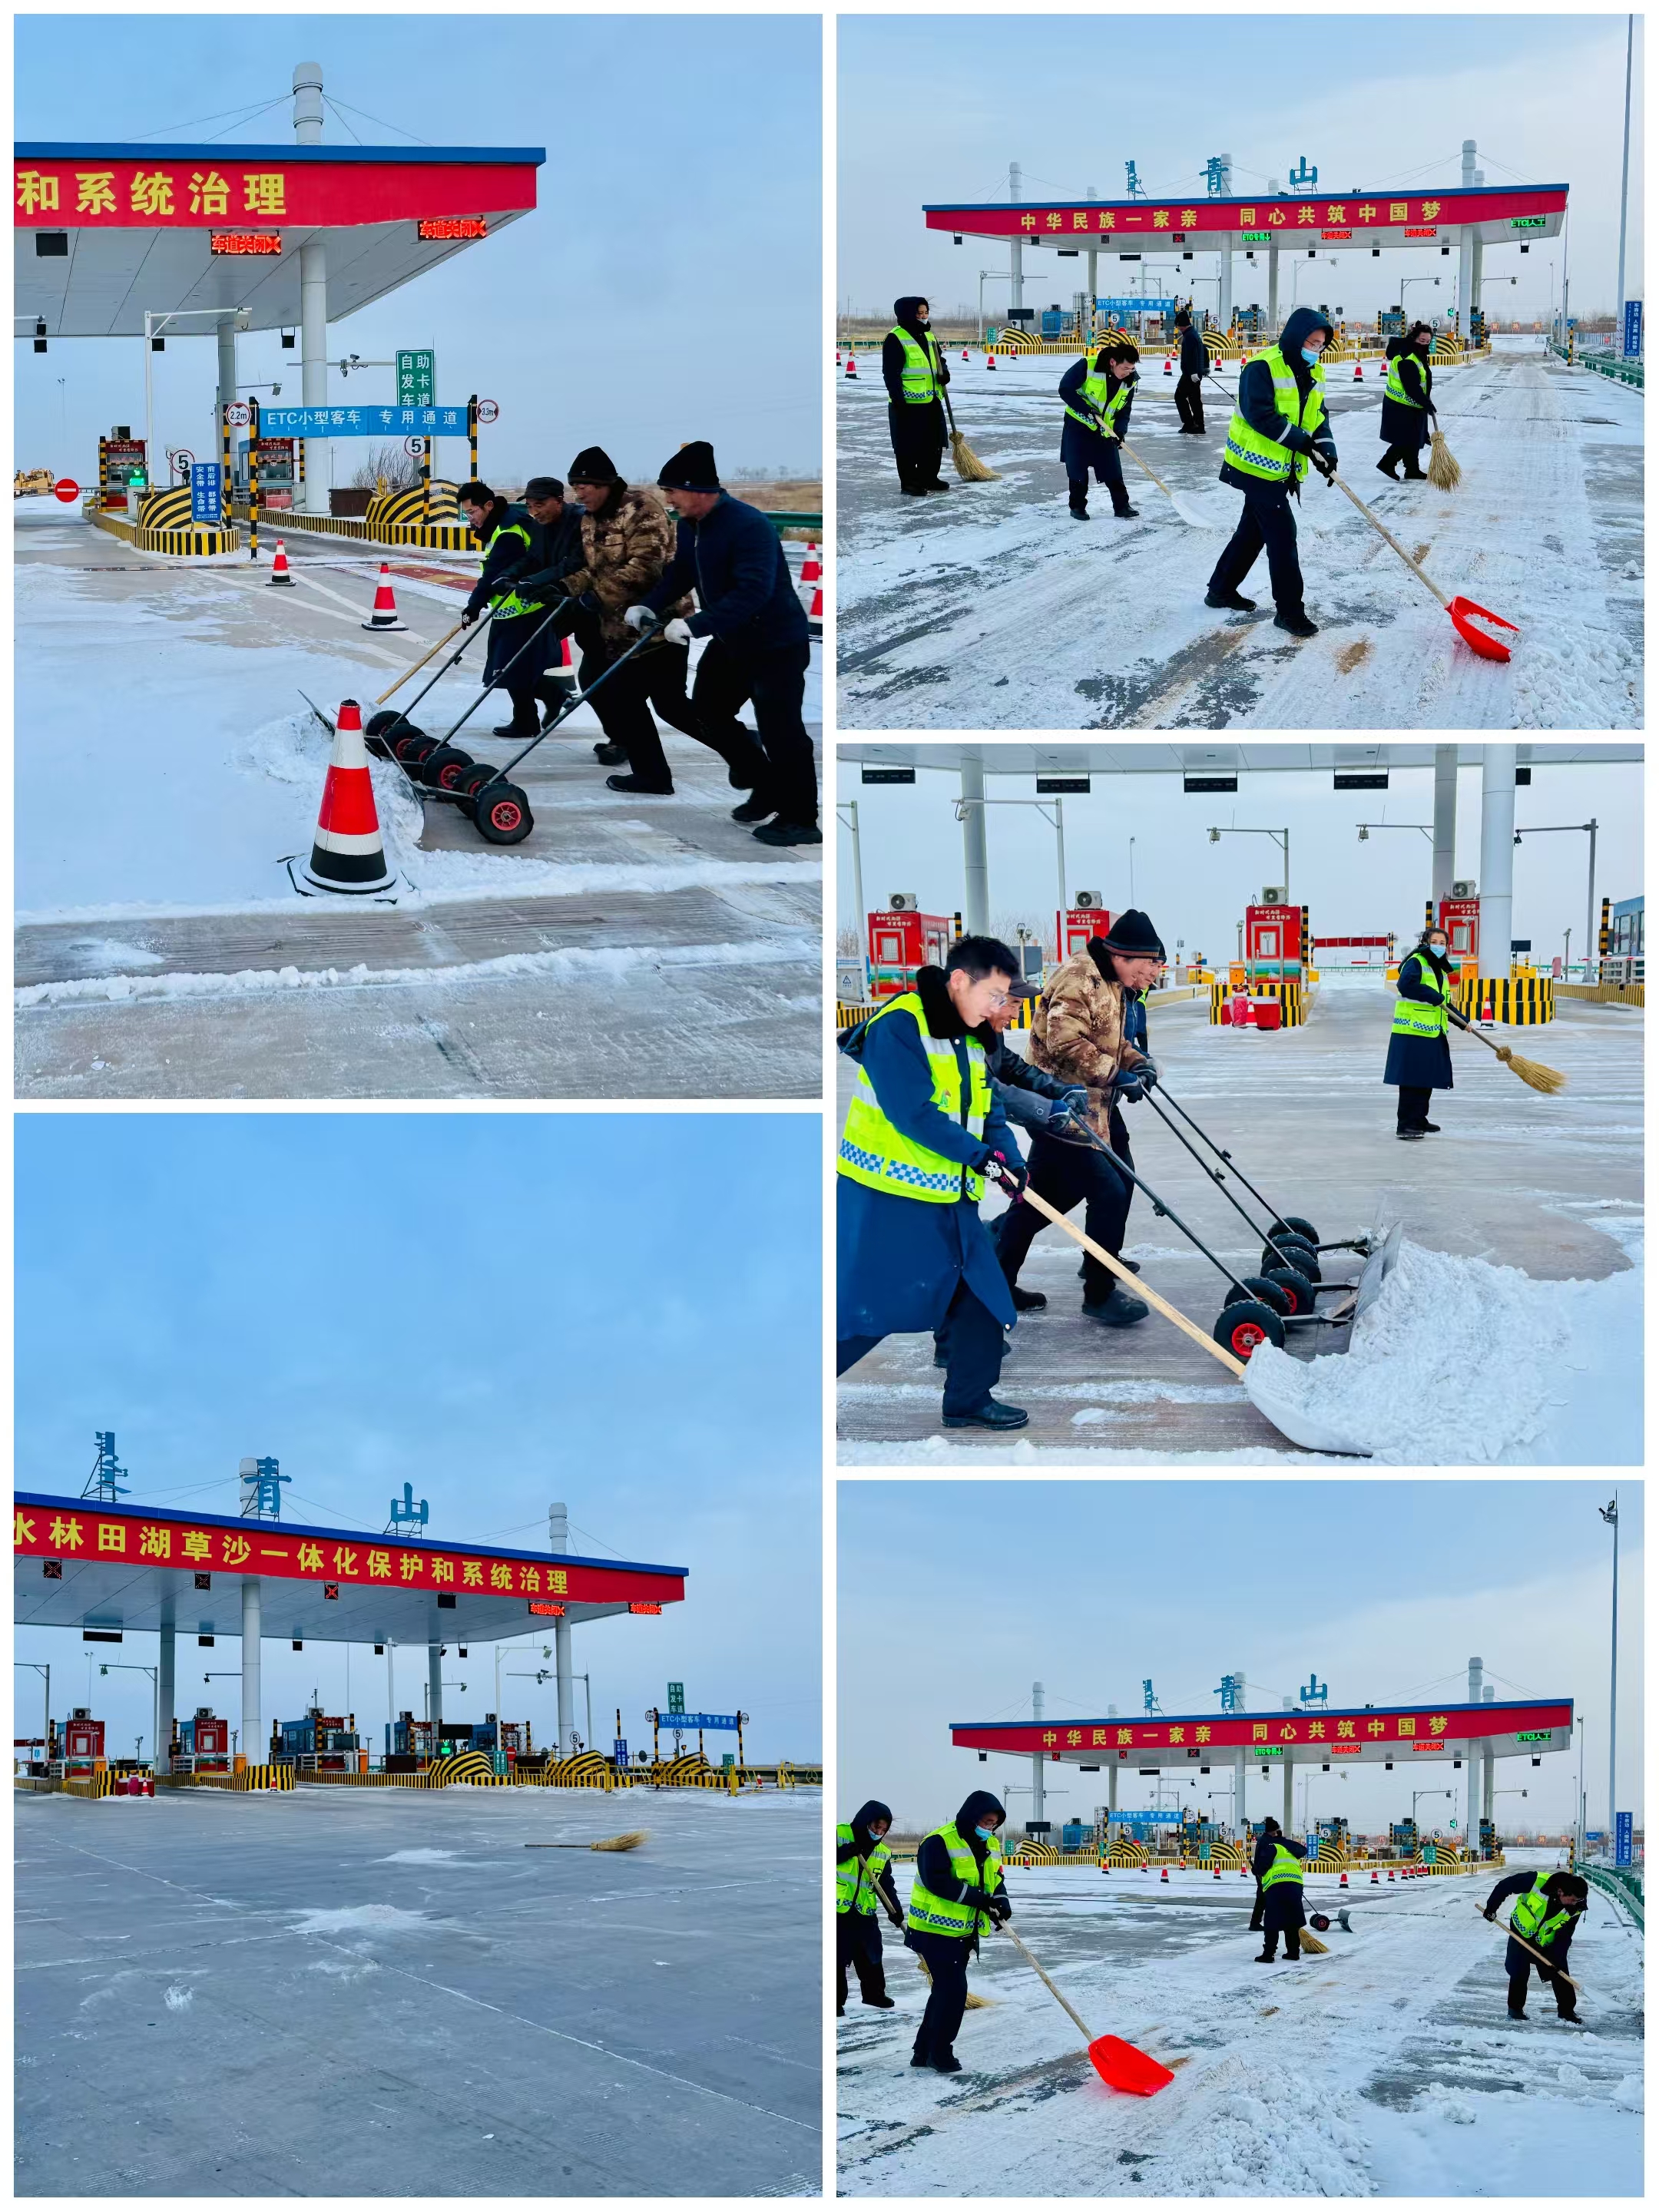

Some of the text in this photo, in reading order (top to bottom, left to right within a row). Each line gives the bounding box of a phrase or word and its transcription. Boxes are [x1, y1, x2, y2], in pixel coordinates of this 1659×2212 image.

[17, 171, 286, 215] 和系统治理
[1021, 201, 1441, 230] 中华民族一家亲 同心共筑中国梦
[420, 220, 472, 239] 车道关闭
[211, 235, 267, 254] 车道关闭
[402, 355, 429, 369] 自助
[401, 373, 430, 389] 发卡
[401, 393, 430, 406] 车道
[230, 411, 247, 419] 2.2m
[267, 409, 457, 425] ETC小型客车 专用通道
[411, 439, 422, 453] 5
[178, 455, 189, 469] 5
[196, 466, 204, 487] 安全带
[14, 1512, 568, 1594] 水林田湖草沙一体化保护和系统治理
[670, 1684, 682, 1693] 自助
[671, 1705, 683, 1714] 车道
[707, 1717, 734, 1725] 专用通道
[572, 1734, 578, 1743] 5
[675, 1729, 680, 1738] 5
[1042, 1716, 1448, 1747] 中华民族一家亲 同心共筑中国梦
